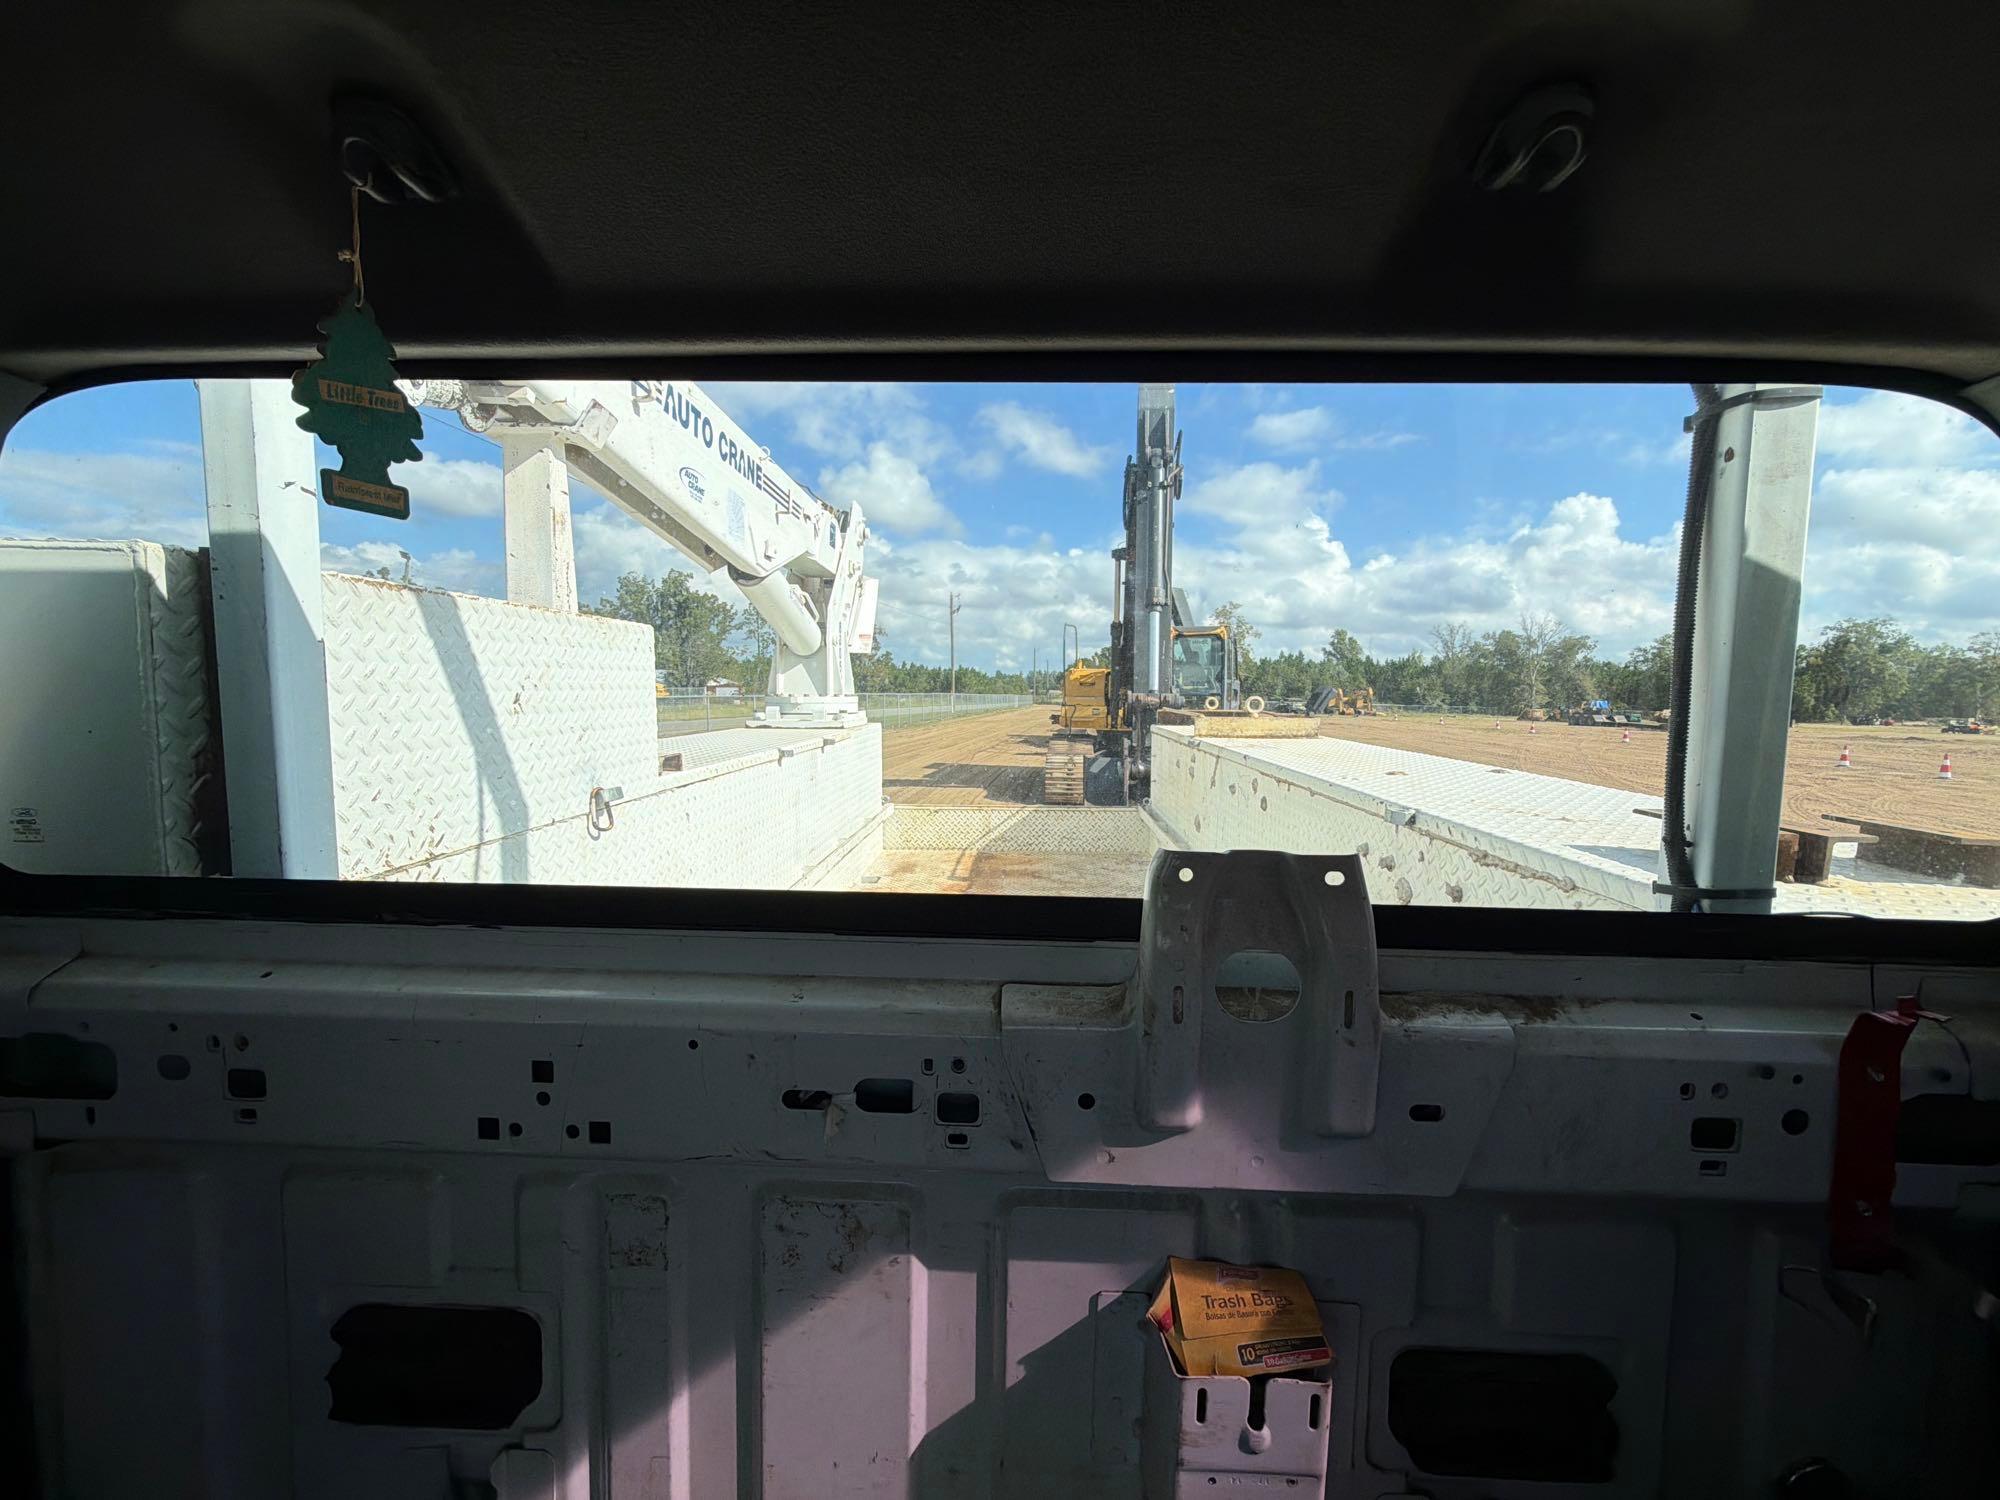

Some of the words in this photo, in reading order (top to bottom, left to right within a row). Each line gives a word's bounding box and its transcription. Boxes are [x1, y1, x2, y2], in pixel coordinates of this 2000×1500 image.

[327, 383, 362, 404] Little
[368, 391, 400, 410] Trees
[664, 384, 713, 448] AUTO
[719, 432, 763, 490] CRANE
[684, 469, 699, 483] AUTO
[688, 480, 705, 496] CRANE
[1201, 1294, 1250, 1310] Trash
[1252, 1292, 1294, 1310] Bags
[1205, 1311, 1227, 1321] Bolsas
[1227, 1311, 1236, 1319] de
[1240, 1347, 1256, 1362] 10
